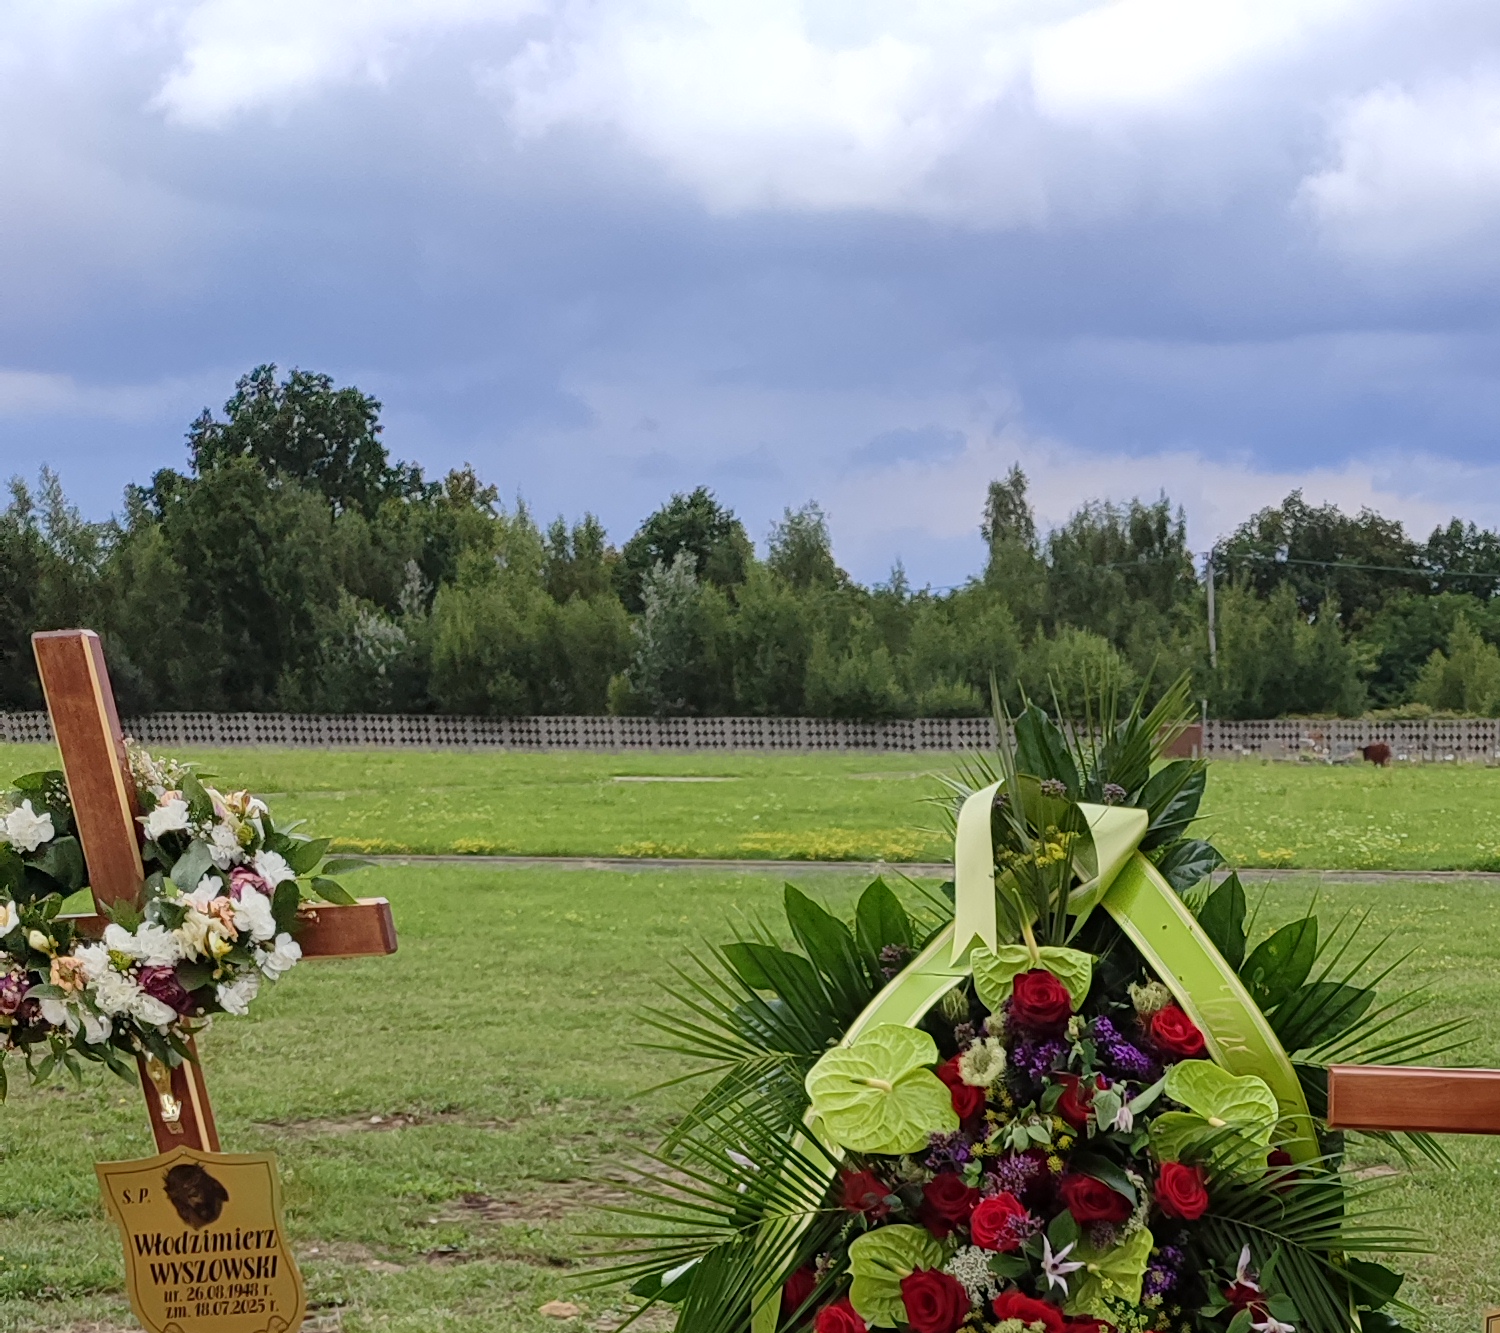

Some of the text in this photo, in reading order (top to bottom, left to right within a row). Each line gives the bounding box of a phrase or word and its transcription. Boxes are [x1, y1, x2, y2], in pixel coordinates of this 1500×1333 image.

[134, 1227, 278, 1257] Włodzimierz
[150, 1255, 278, 1285] WYSZOWSKI
[164, 1290, 183, 1303] ur.
[186, 1283, 259, 1301] 26.08.1948
[166, 1305, 191, 1319] zm.
[194, 1299, 266, 1317] 18.07.2025
